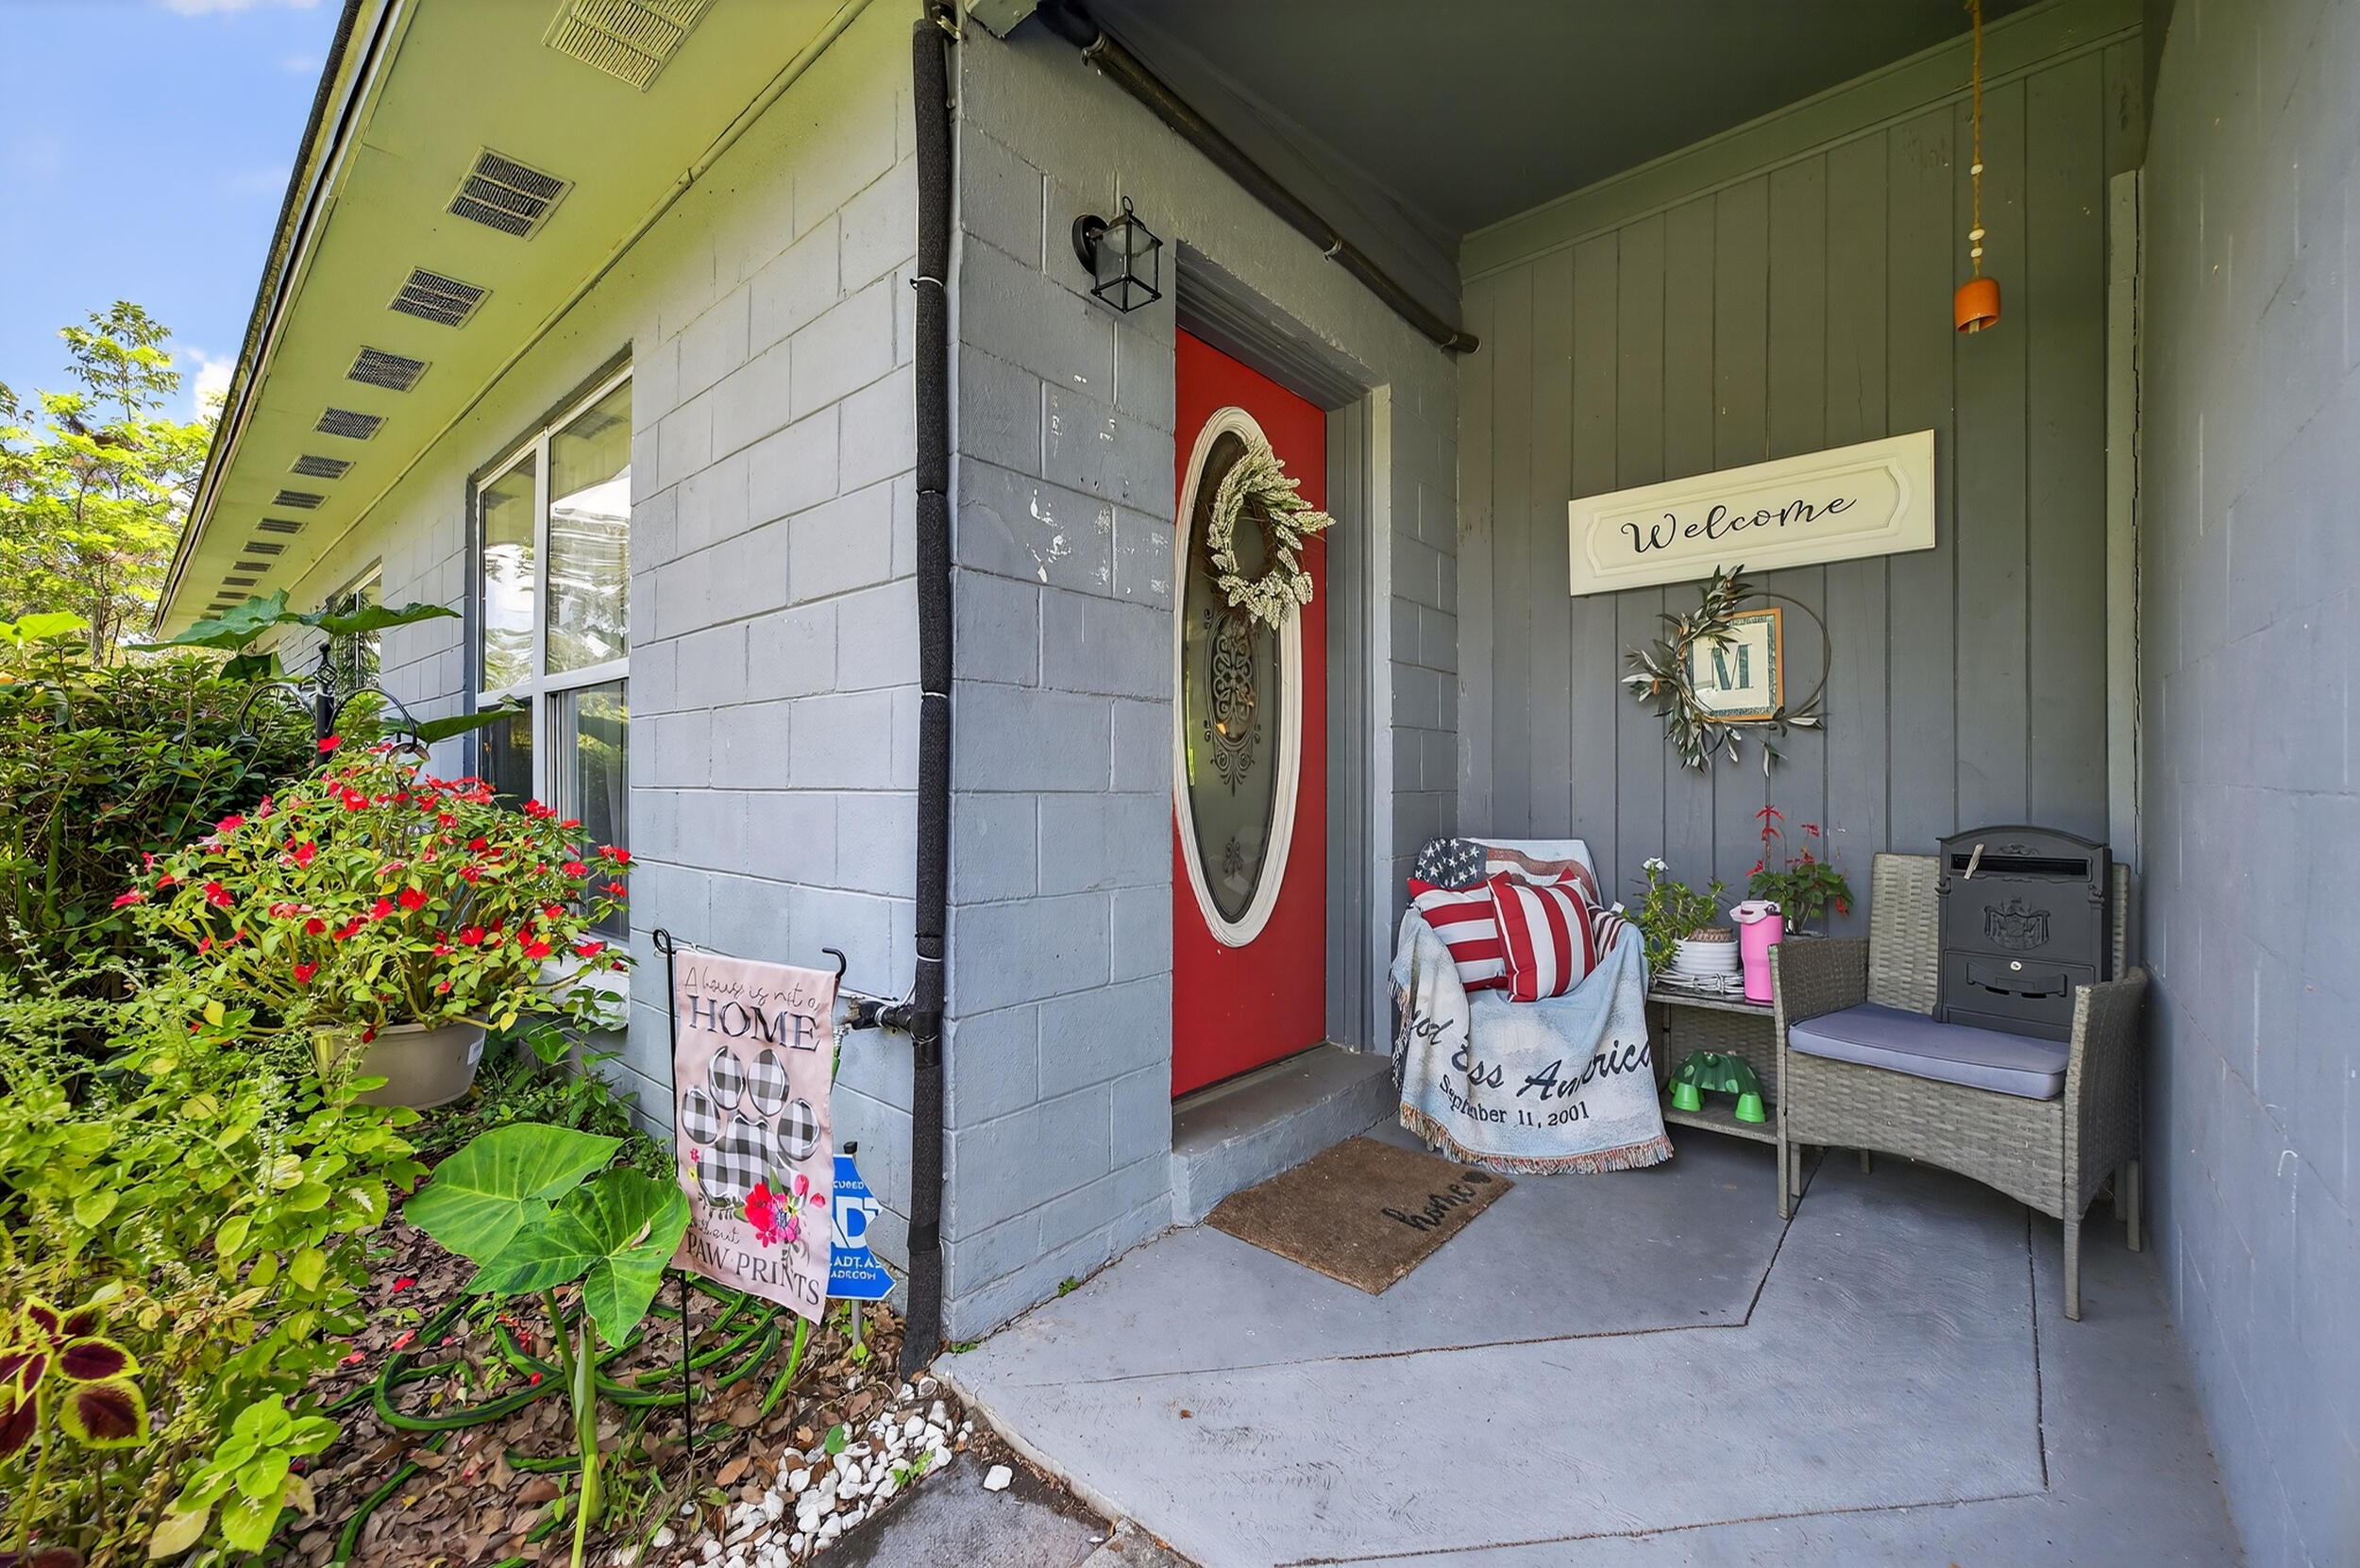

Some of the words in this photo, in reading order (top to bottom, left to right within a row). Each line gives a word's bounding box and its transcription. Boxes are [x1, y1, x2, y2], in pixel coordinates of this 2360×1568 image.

[1620, 497, 1858, 553] Welcome
[1707, 643, 1754, 690] M
[686, 994, 821, 1052] HOME
[1547, 1101, 1590, 1126] 2001
[1381, 1184, 1475, 1231] home
[685, 1231, 730, 1270] PAW
[735, 1252, 819, 1306] PRINTS
